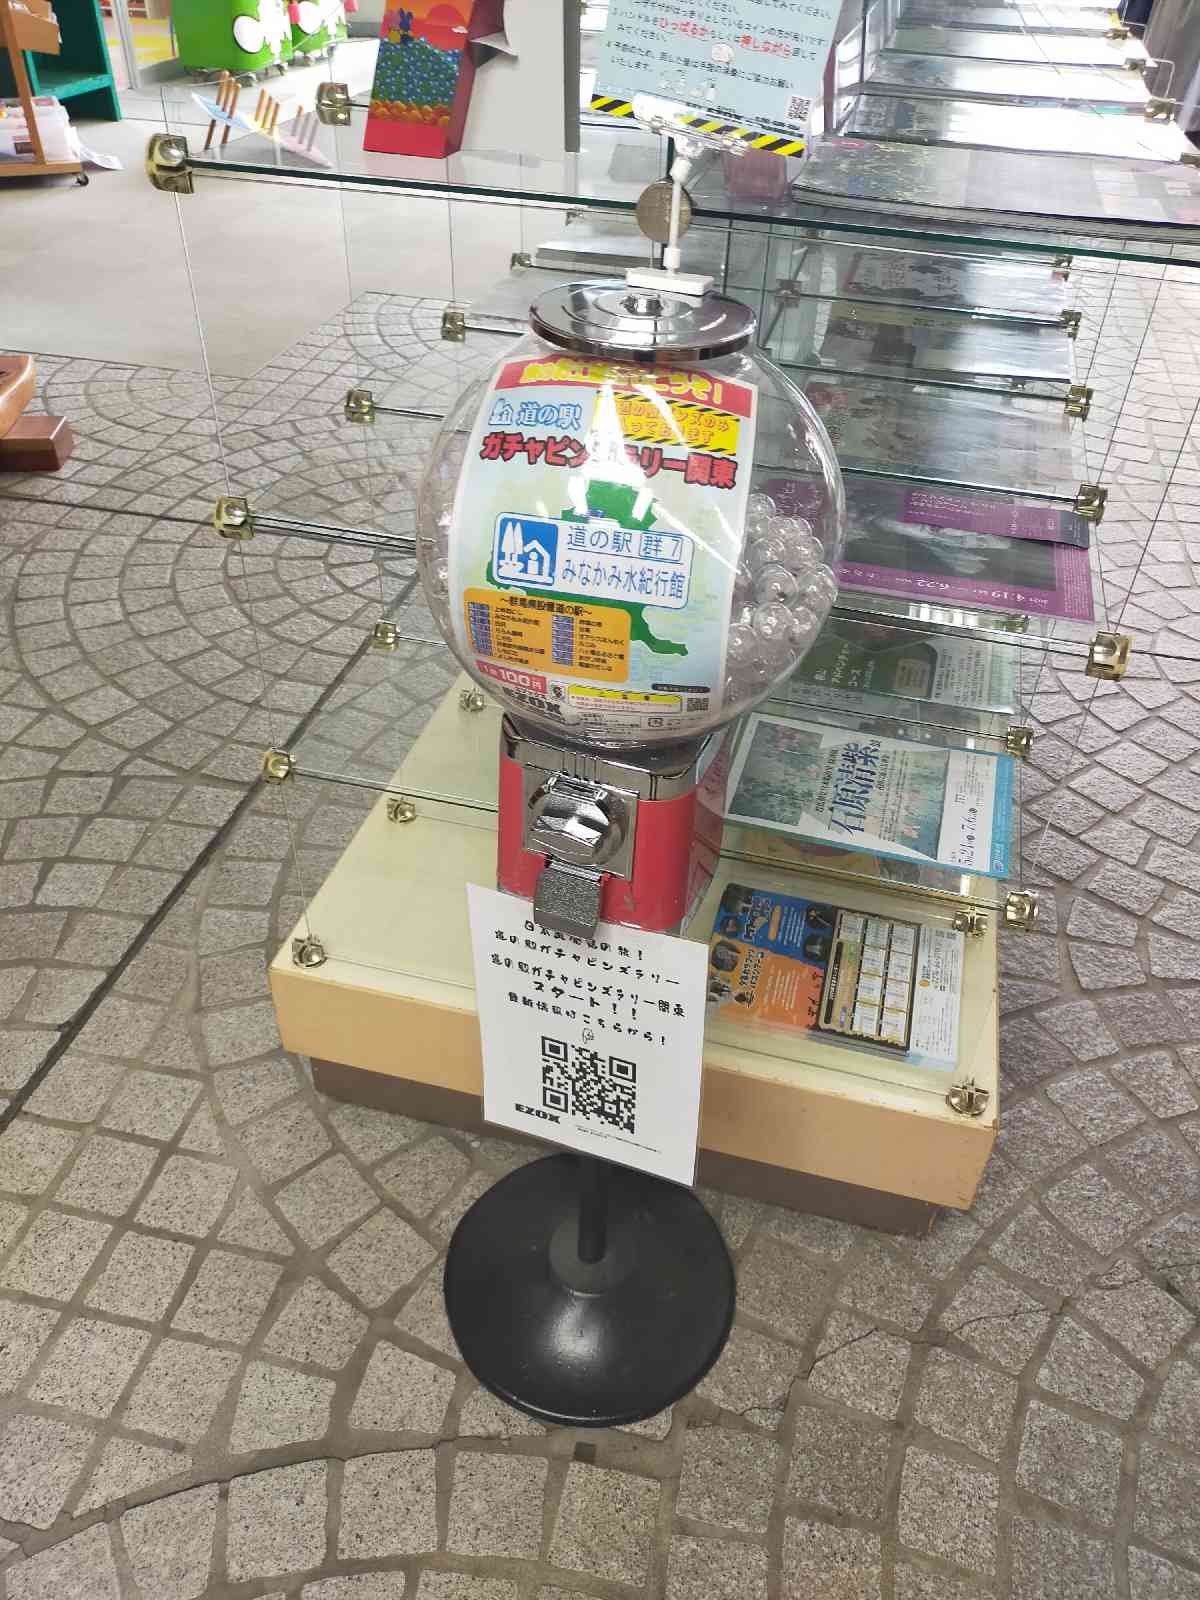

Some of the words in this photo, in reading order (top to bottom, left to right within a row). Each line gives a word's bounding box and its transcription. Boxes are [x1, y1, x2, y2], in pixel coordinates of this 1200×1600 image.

[517, 400, 582, 429] 道の駅
[567, 526, 632, 552] 道の駅
[561, 559, 687, 600] みなかみ水紀行館
[514, 1103, 561, 1124] EZOX
